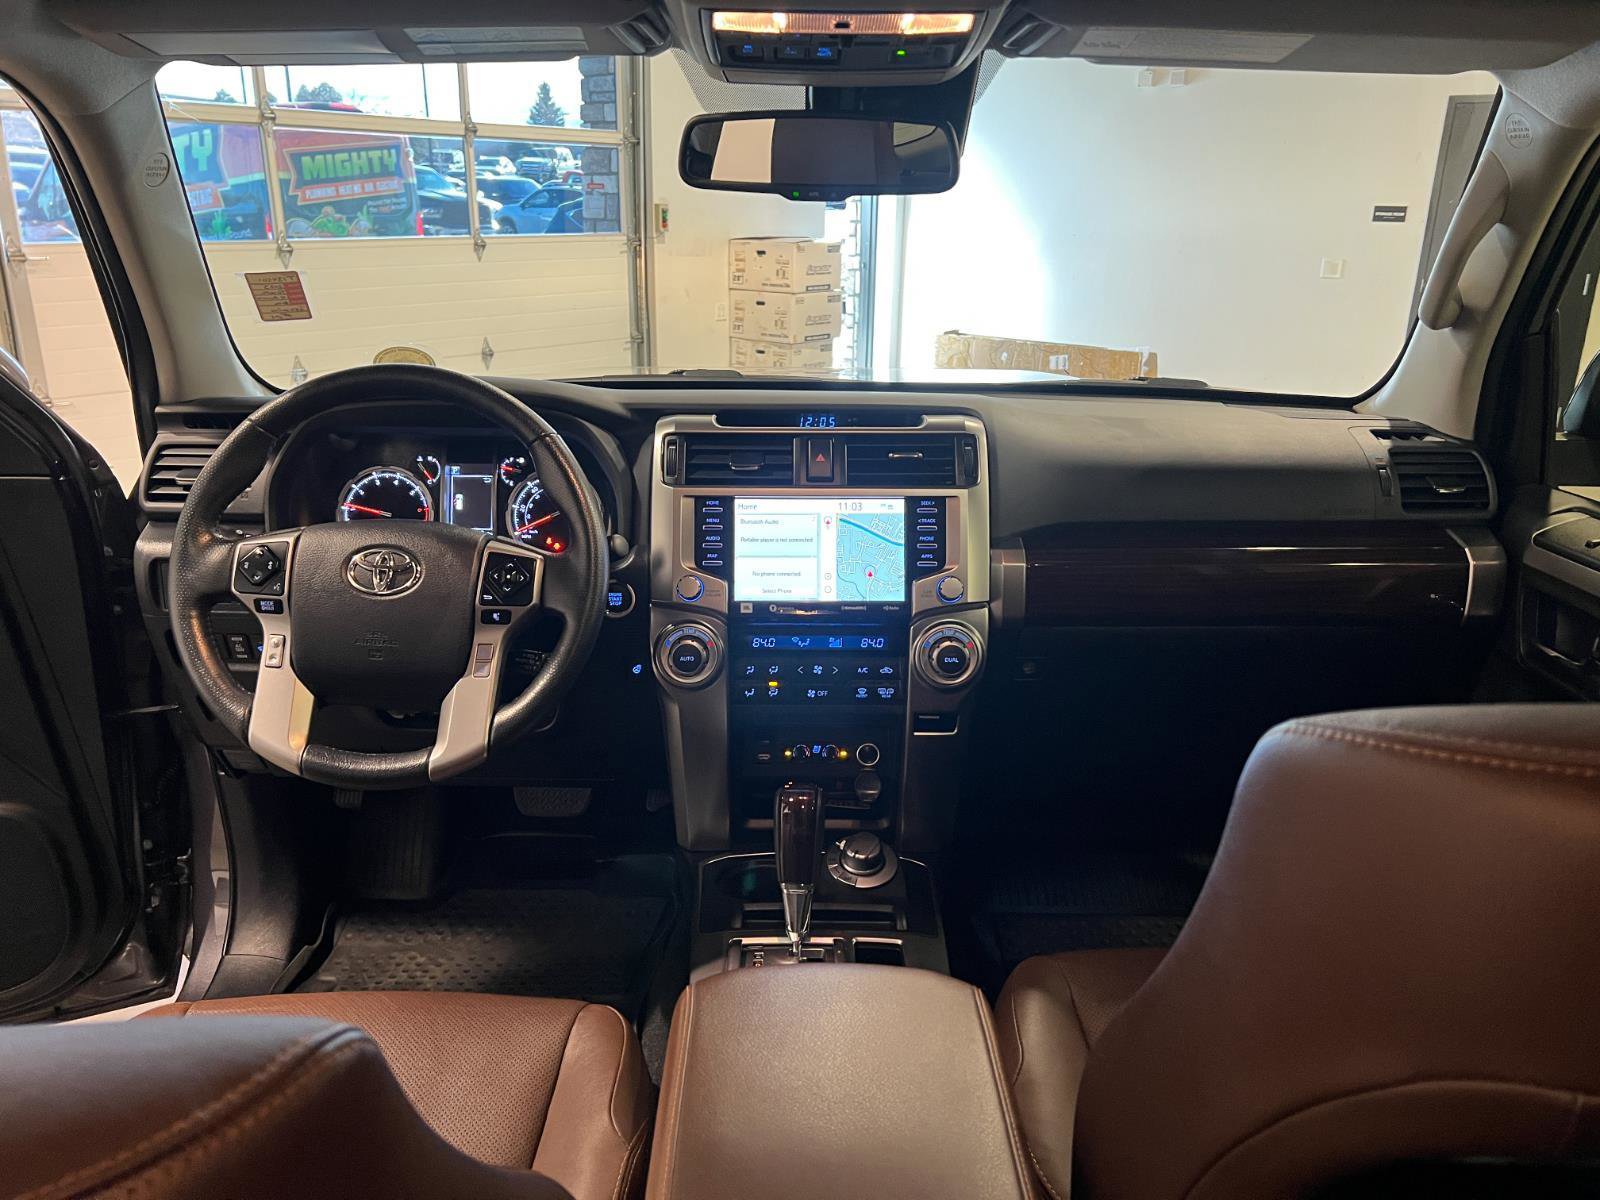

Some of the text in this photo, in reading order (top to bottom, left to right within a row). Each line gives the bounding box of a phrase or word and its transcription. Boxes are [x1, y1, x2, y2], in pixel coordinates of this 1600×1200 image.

[301, 149, 398, 181] MIGHTY
[800, 416, 835, 428] 12:05
[838, 502, 863, 511] 11:03
